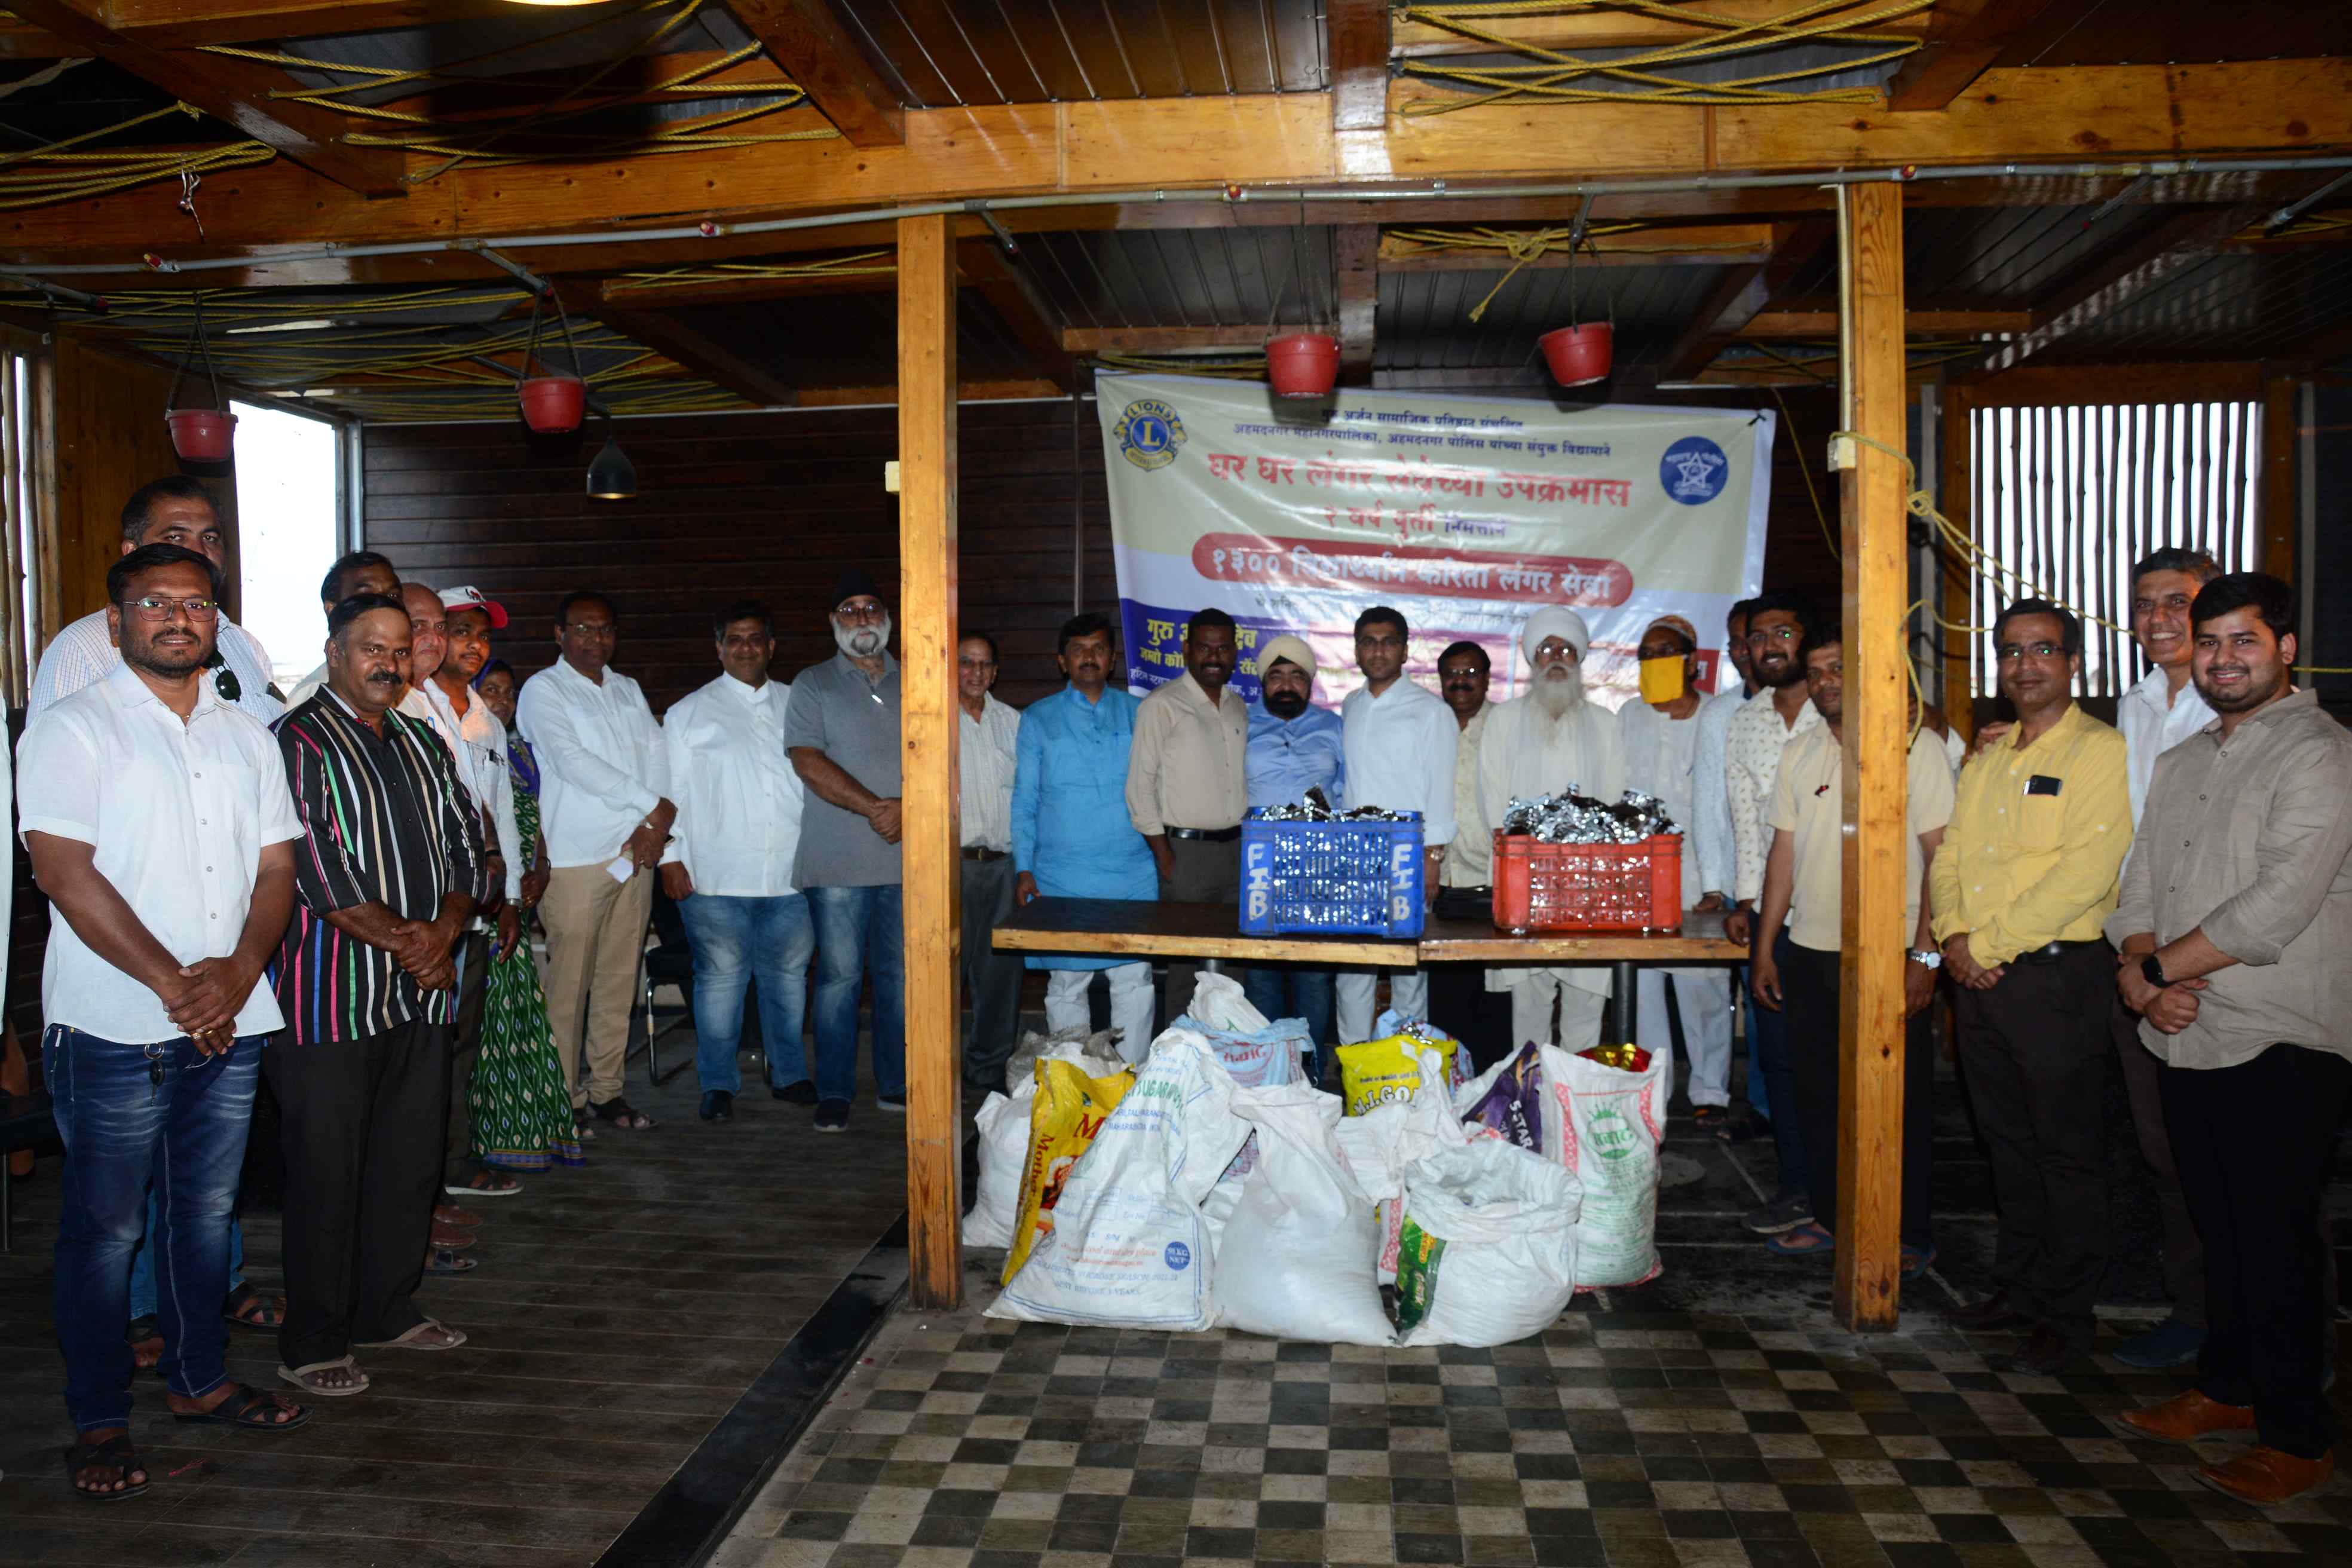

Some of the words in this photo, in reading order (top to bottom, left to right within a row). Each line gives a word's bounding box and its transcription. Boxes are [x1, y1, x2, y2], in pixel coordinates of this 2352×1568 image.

[1129, 402, 1172, 417] LIONS
[1142, 421, 1160, 446] L
[1233, 423, 1291, 436] अहमदनगर
[1387, 433, 1444, 446] अहमदनगर
[1208, 452, 1248, 480] घर
[1257, 457, 1297, 485] घर
[1306, 449, 1374, 489] लंगर
[1496, 472, 1633, 507] उपक्रमास
[1497, 561, 1553, 593] लंगर
[1032, 1133, 1055, 1196] Mother
